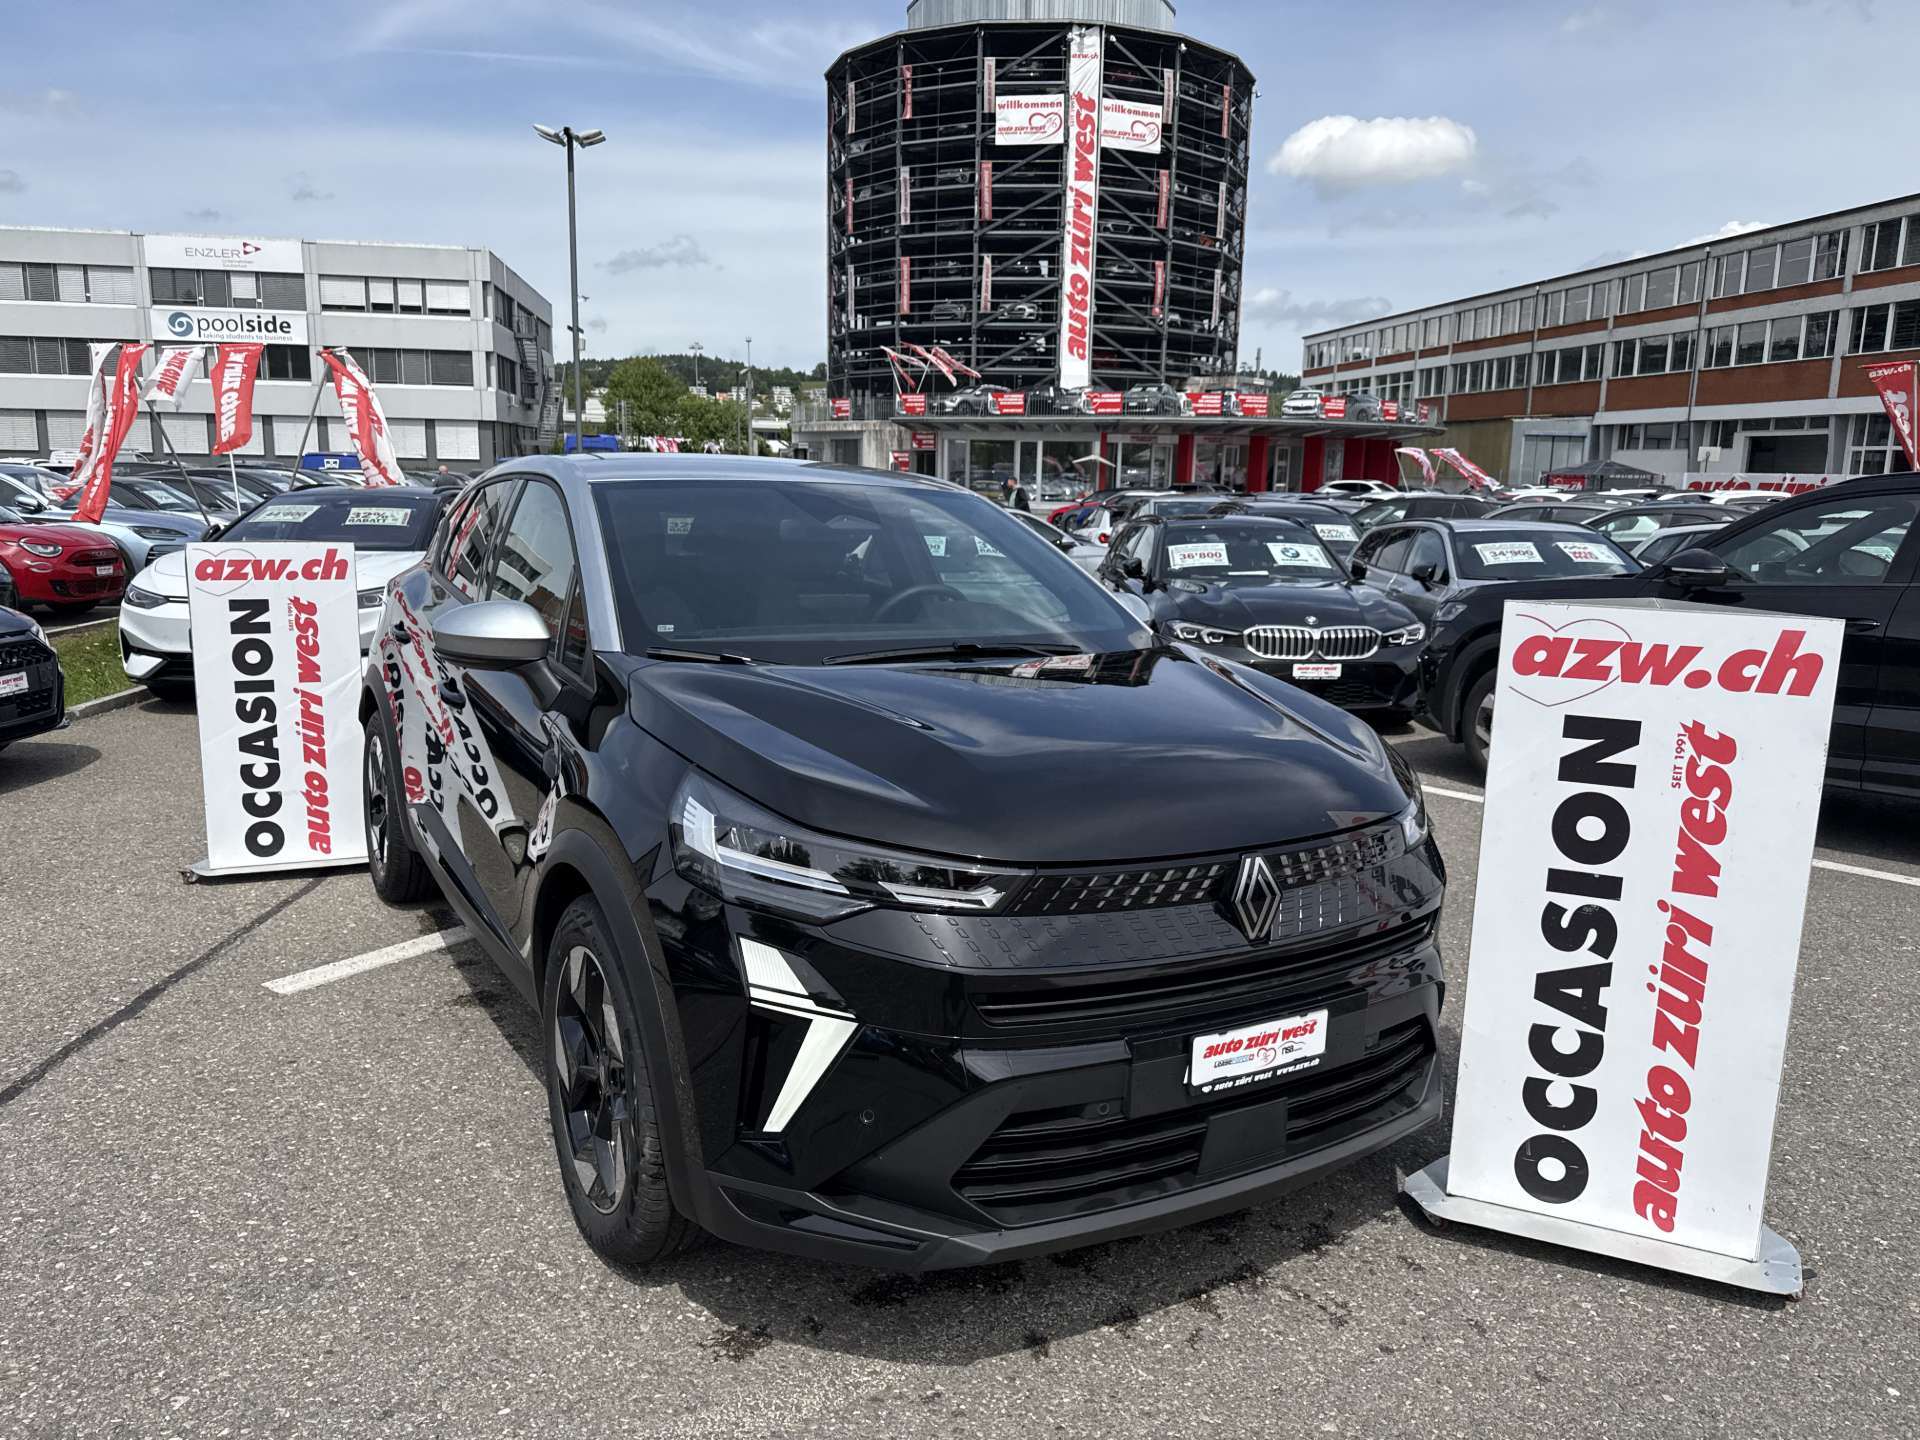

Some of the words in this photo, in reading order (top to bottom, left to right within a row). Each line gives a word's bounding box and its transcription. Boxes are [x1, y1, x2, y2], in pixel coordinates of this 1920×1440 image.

[998, 100, 1062, 110] willkommen
[1104, 104, 1160, 119] willkommen
[1074, 91, 1096, 181] west
[185, 247, 240, 258] ENZLER
[1067, 185, 1093, 272] züri
[198, 314, 292, 338] poolside
[264, 334, 293, 342] business
[1065, 274, 1090, 361] auto
[1868, 364, 1912, 378] azw.ch
[195, 548, 349, 581] azw.ch
[1179, 552, 1222, 560] 36'800
[287, 594, 322, 684] west
[1512, 629, 1824, 697] azw.ch
[229, 598, 285, 858] OCCASION
[292, 687, 328, 770] züri
[1674, 732, 1688, 760] 1991
[1671, 764, 1684, 789] SEIT
[300, 770, 332, 855] auto
[1671, 719, 1738, 899] west
[1514, 713, 1643, 1205] OCCASION
[1646, 897, 1714, 1070] züri
[1203, 1037, 1244, 1059] auto
[1244, 1028, 1280, 1050] züri
[1282, 1020, 1318, 1042] west
[1214, 1080, 1233, 1091] auto
[1234, 1075, 1253, 1087] züri
[1254, 1070, 1273, 1081] west
[1633, 1065, 1692, 1234] auto
